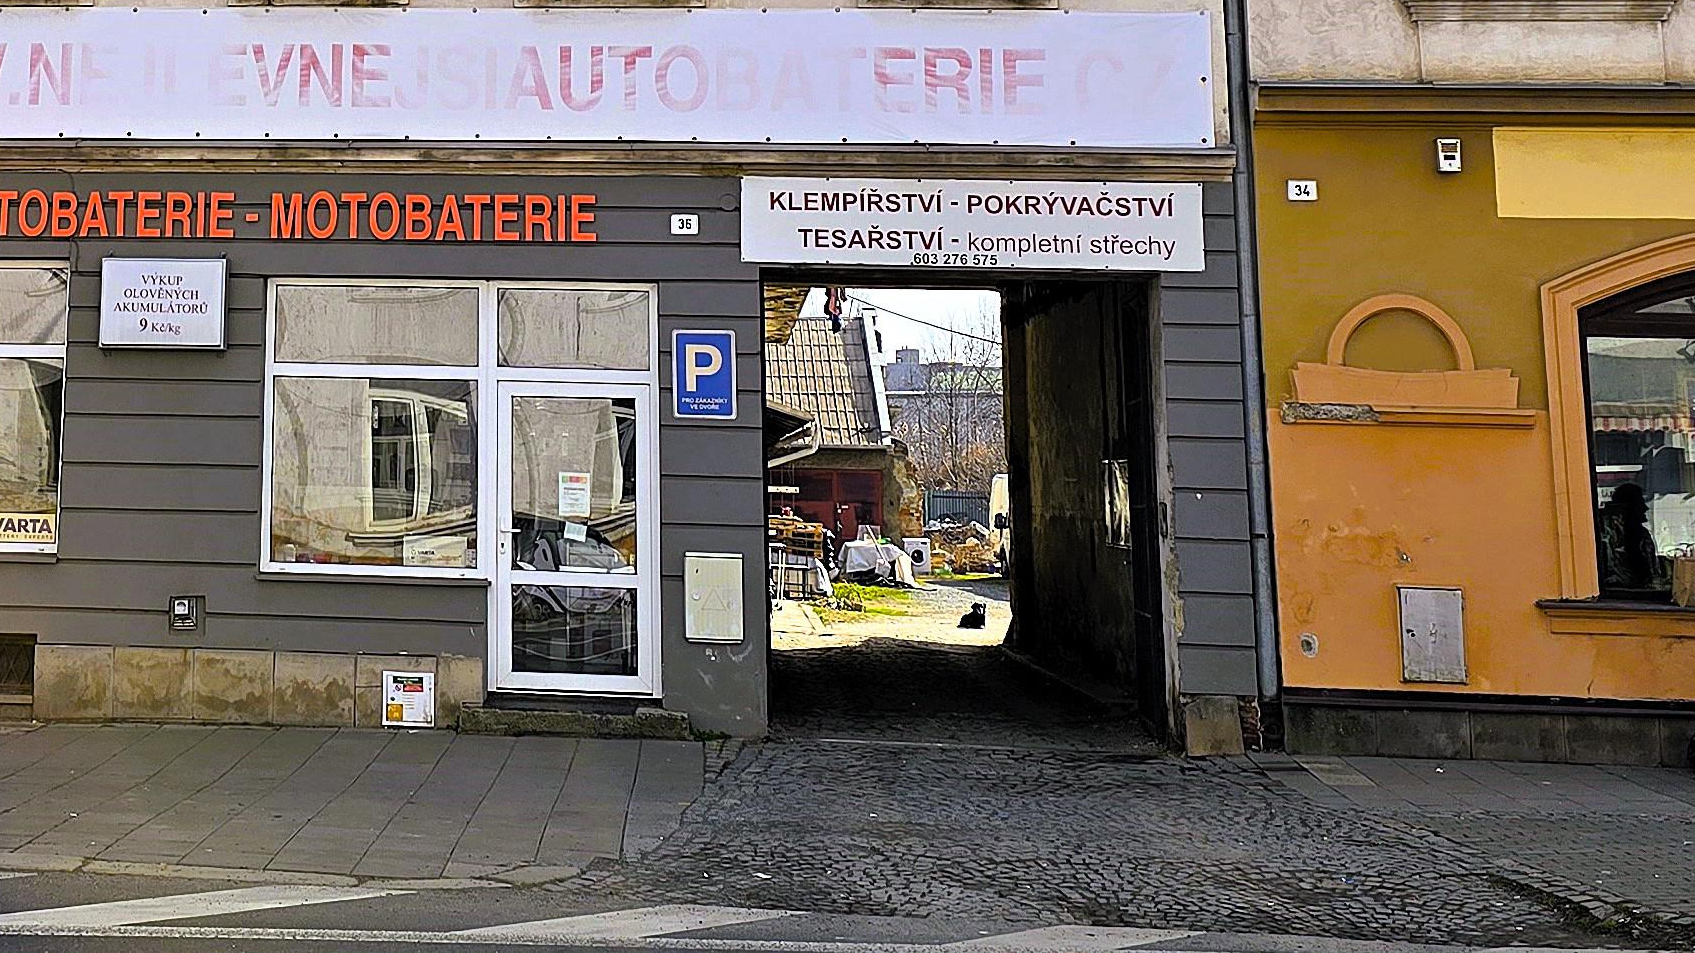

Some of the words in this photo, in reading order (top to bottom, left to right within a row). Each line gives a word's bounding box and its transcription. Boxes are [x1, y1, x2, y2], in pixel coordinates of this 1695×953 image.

[1294, 184, 1311, 197] 34
[769, 188, 943, 213] KLEMPÍŘSTVÍ
[966, 191, 1175, 217] POKRÝVAČSTVÍ
[270, 192, 599, 242] MOTOBATERIE
[678, 218, 692, 230] 36
[797, 224, 944, 251] TESAŘSTVÍ
[967, 232, 1082, 258] kompletní
[1089, 234, 1176, 261] střechy
[913, 252, 939, 265] 603
[942, 253, 968, 265] 276
[972, 254, 998, 266] 575
[141, 271, 184, 286] VÝKUP
[123, 286, 199, 301] OLOVĚNÝCH
[113, 300, 209, 315] AKUMULÁTORŮ
[139, 317, 148, 333] 9
[151, 321, 181, 336] Kč/kg
[685, 343, 723, 392] P
